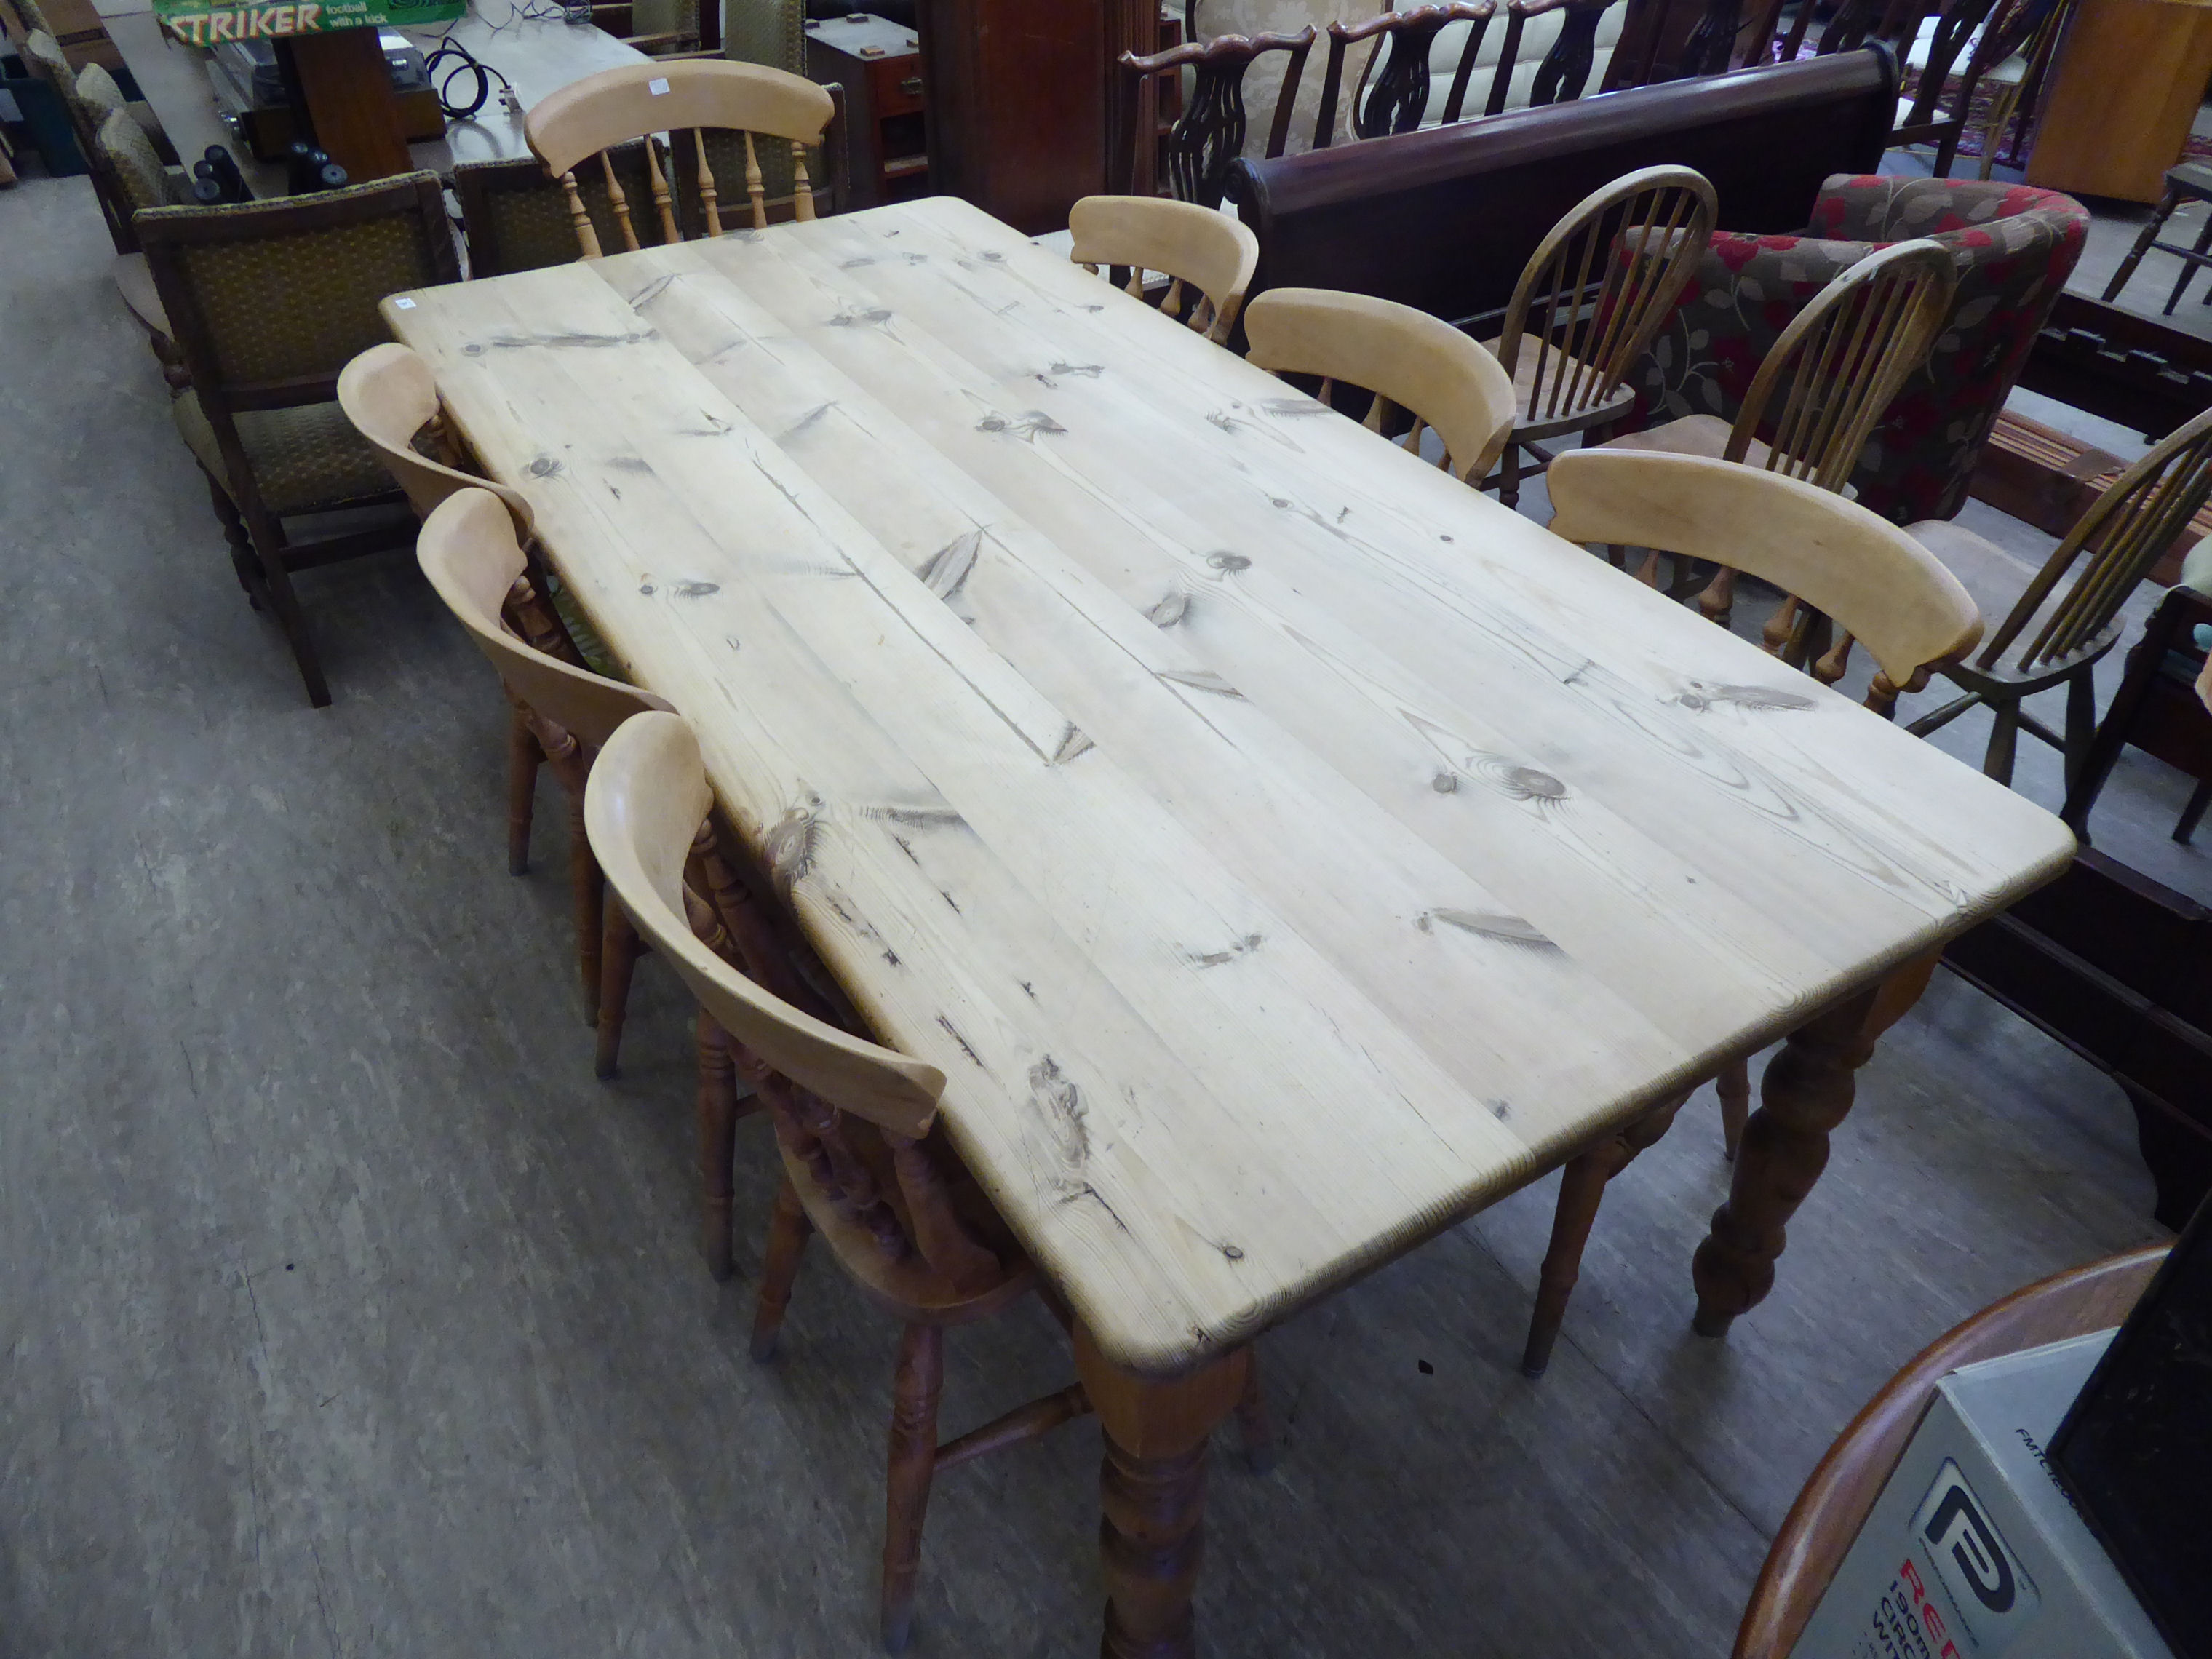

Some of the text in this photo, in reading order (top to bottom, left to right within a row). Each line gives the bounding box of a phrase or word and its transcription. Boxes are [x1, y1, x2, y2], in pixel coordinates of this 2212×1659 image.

[326, 2, 367, 15] football
[169, 3, 322, 46] STRIKER
[329, 12, 389, 28] with a kick
